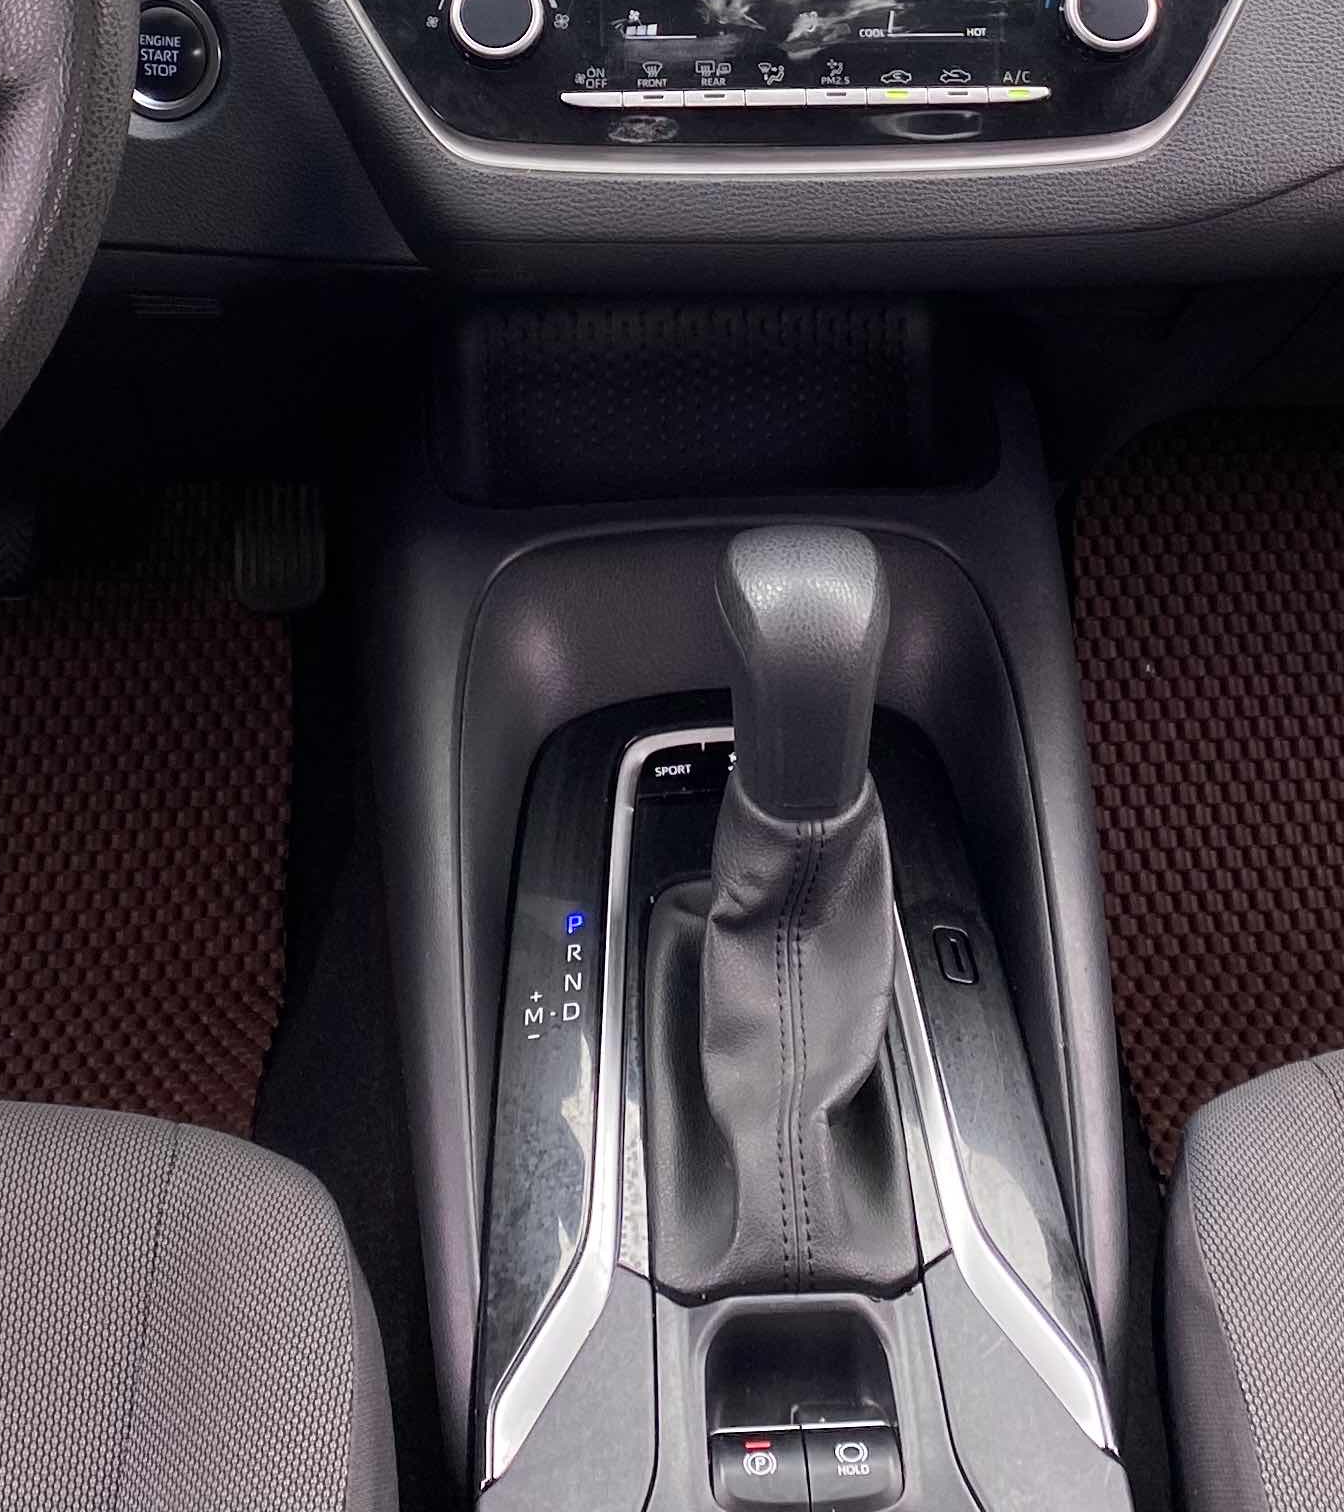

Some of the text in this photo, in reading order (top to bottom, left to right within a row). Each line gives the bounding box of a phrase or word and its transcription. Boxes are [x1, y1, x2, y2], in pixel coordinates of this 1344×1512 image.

[859, 28, 885, 38] COOL
[966, 27, 987, 37] HOT
[139, 34, 181, 47] ENGINE
[140, 48, 179, 63] START
[144, 63, 177, 77] STOP
[586, 67, 605, 78] ON
[586, 78, 608, 88] OFF
[637, 78, 667, 87] FRONT
[701, 77, 726, 86] REAR
[821, 75, 850, 85] PM2.5
[1002, 70, 1032, 84] A/C
[654, 764, 692, 777] SPORT
[567, 915, 584, 934] P
[567, 944, 582, 962] R
[564, 973, 582, 992] N
[524, 1007, 544, 1026] M
[562, 1002, 581, 1021] D
[837, 1464, 870, 1476] HOLD
